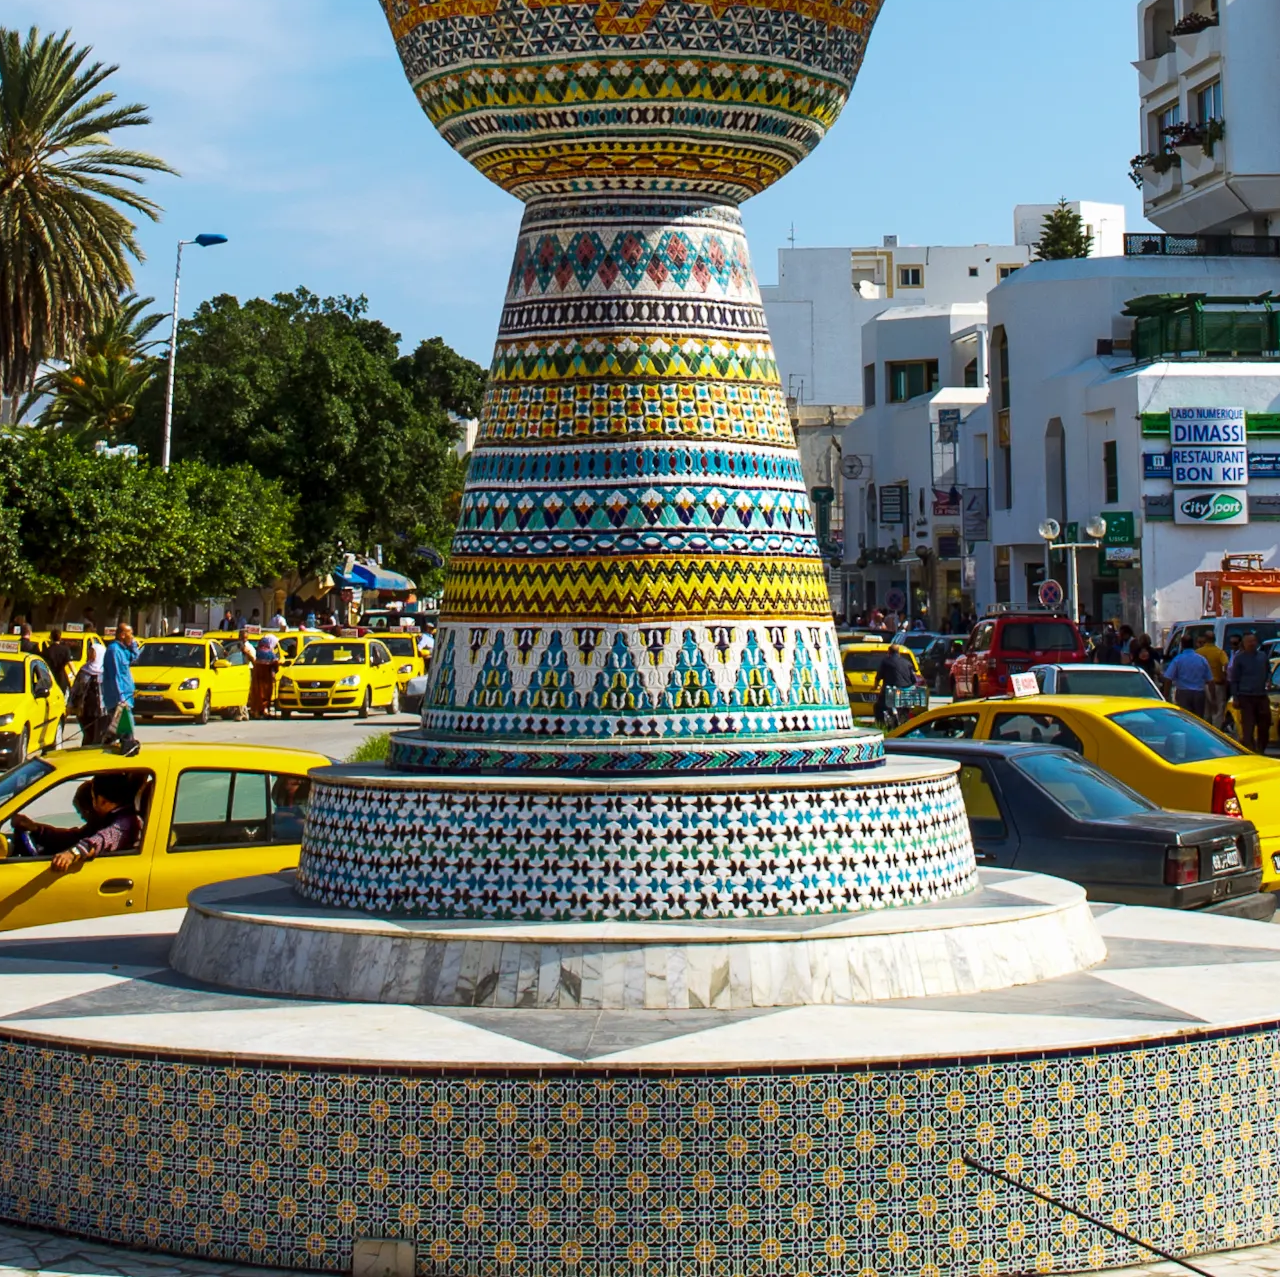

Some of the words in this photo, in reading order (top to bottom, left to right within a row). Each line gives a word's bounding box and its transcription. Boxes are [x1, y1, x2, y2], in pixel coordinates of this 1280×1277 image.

[1172, 409, 1194, 419] LABO
[1197, 409, 1243, 419] NUMERIQUE
[1175, 425, 1243, 442] DIMASSI
[1174, 450, 1245, 463] RESTAURANT
[1176, 467, 1213, 481] BON
[1222, 467, 1245, 481] KIF
